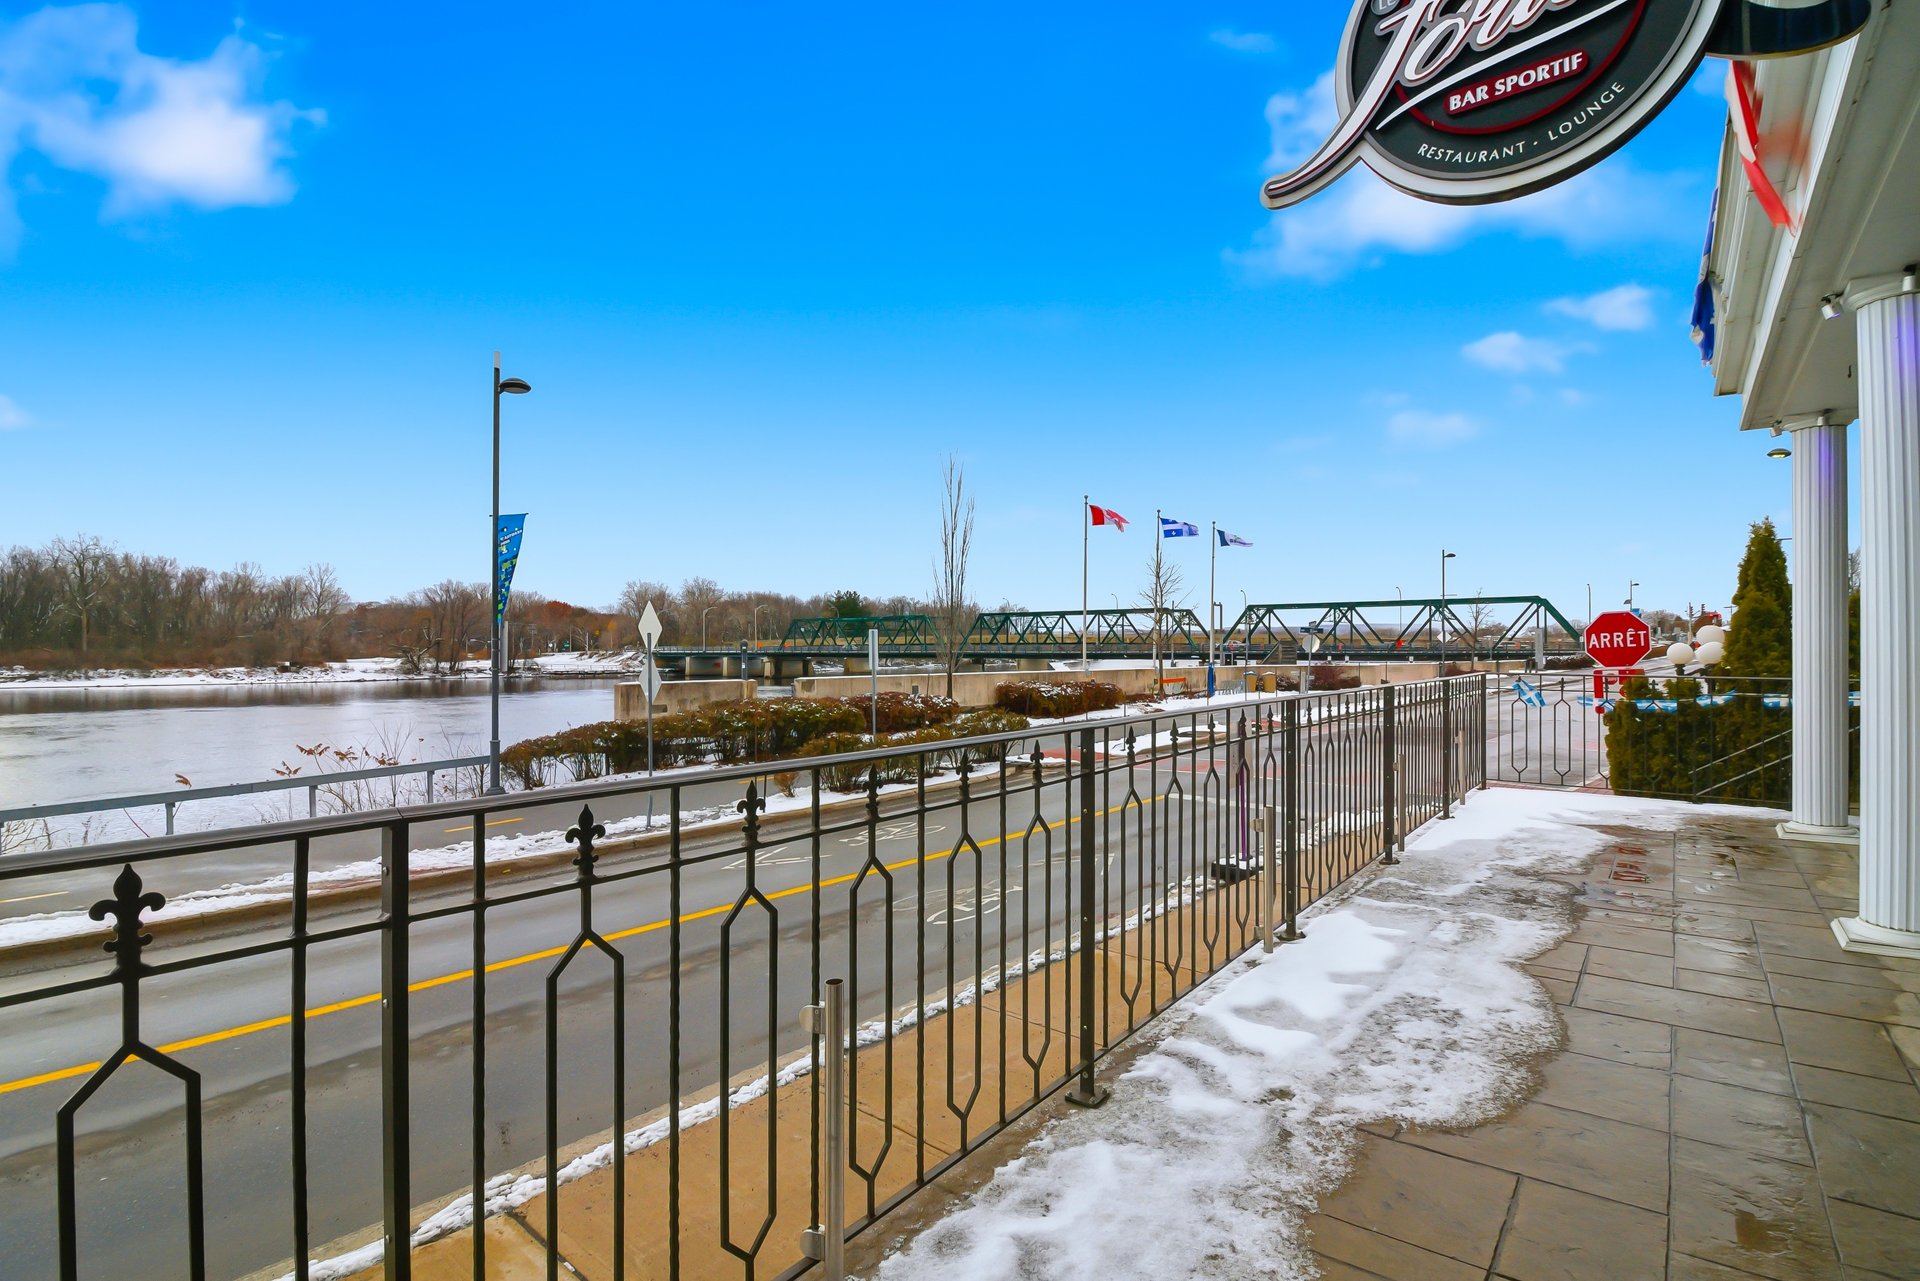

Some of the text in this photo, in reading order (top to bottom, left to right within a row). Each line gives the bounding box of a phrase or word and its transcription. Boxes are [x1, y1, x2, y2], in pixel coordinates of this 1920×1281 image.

[1449, 52, 1583, 111] BAR SPORTIF
[1417, 81, 1625, 163] RESTAURANT LOUNGE
[1588, 628, 1647, 649] ARRÊT
